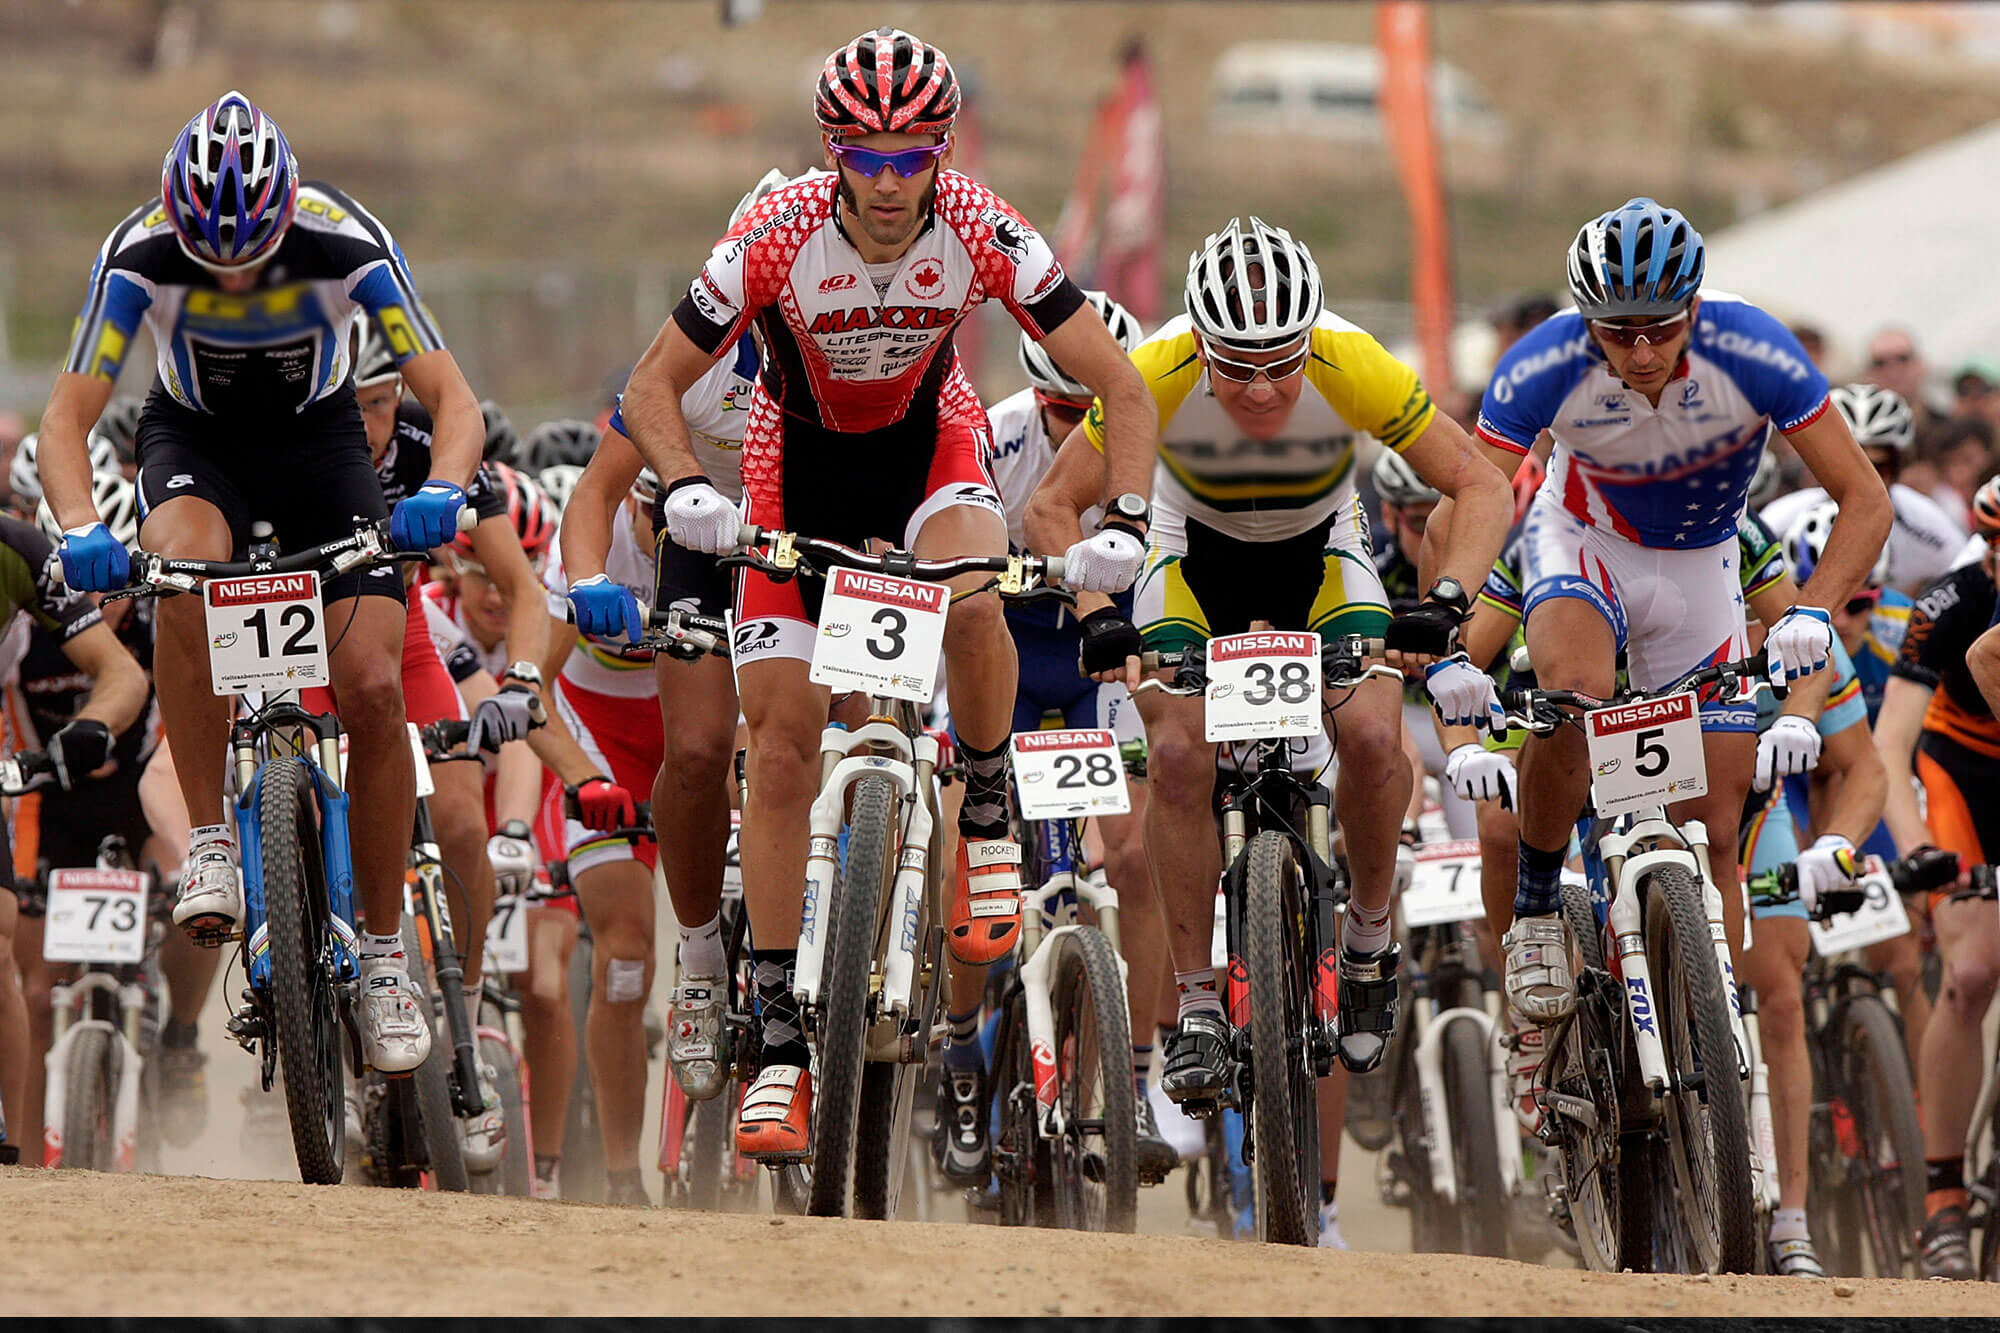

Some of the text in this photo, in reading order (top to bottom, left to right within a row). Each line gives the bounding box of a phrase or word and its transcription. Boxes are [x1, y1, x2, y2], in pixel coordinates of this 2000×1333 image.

[725, 204, 803, 264] LITESPEED
[807, 305, 958, 335] MAXXIS
[827, 331, 930, 347] LITESPEED
[1718, 331, 1809, 381] GIANT
[169, 560, 208, 571] KORE
[219, 577, 304, 598] NISSAN
[844, 573, 935, 603] NISSAN
[243, 604, 319, 658] 12
[866, 608, 908, 661] 3
[1221, 636, 1305, 654] NISSAN
[1243, 662, 1312, 706] 38
[1600, 699, 1684, 727] NISSAN
[1024, 733, 1104, 747] NISSAN
[1635, 727, 1670, 777] 5
[1053, 753, 1118, 789] 28
[62, 871, 134, 888] NISSAN
[84, 897, 137, 932] 73
[801, 879, 820, 945] FOX
[900, 885, 921, 953] FOX
[684, 988, 712, 1000] SIDI
[1626, 976, 1656, 1038] FOX
